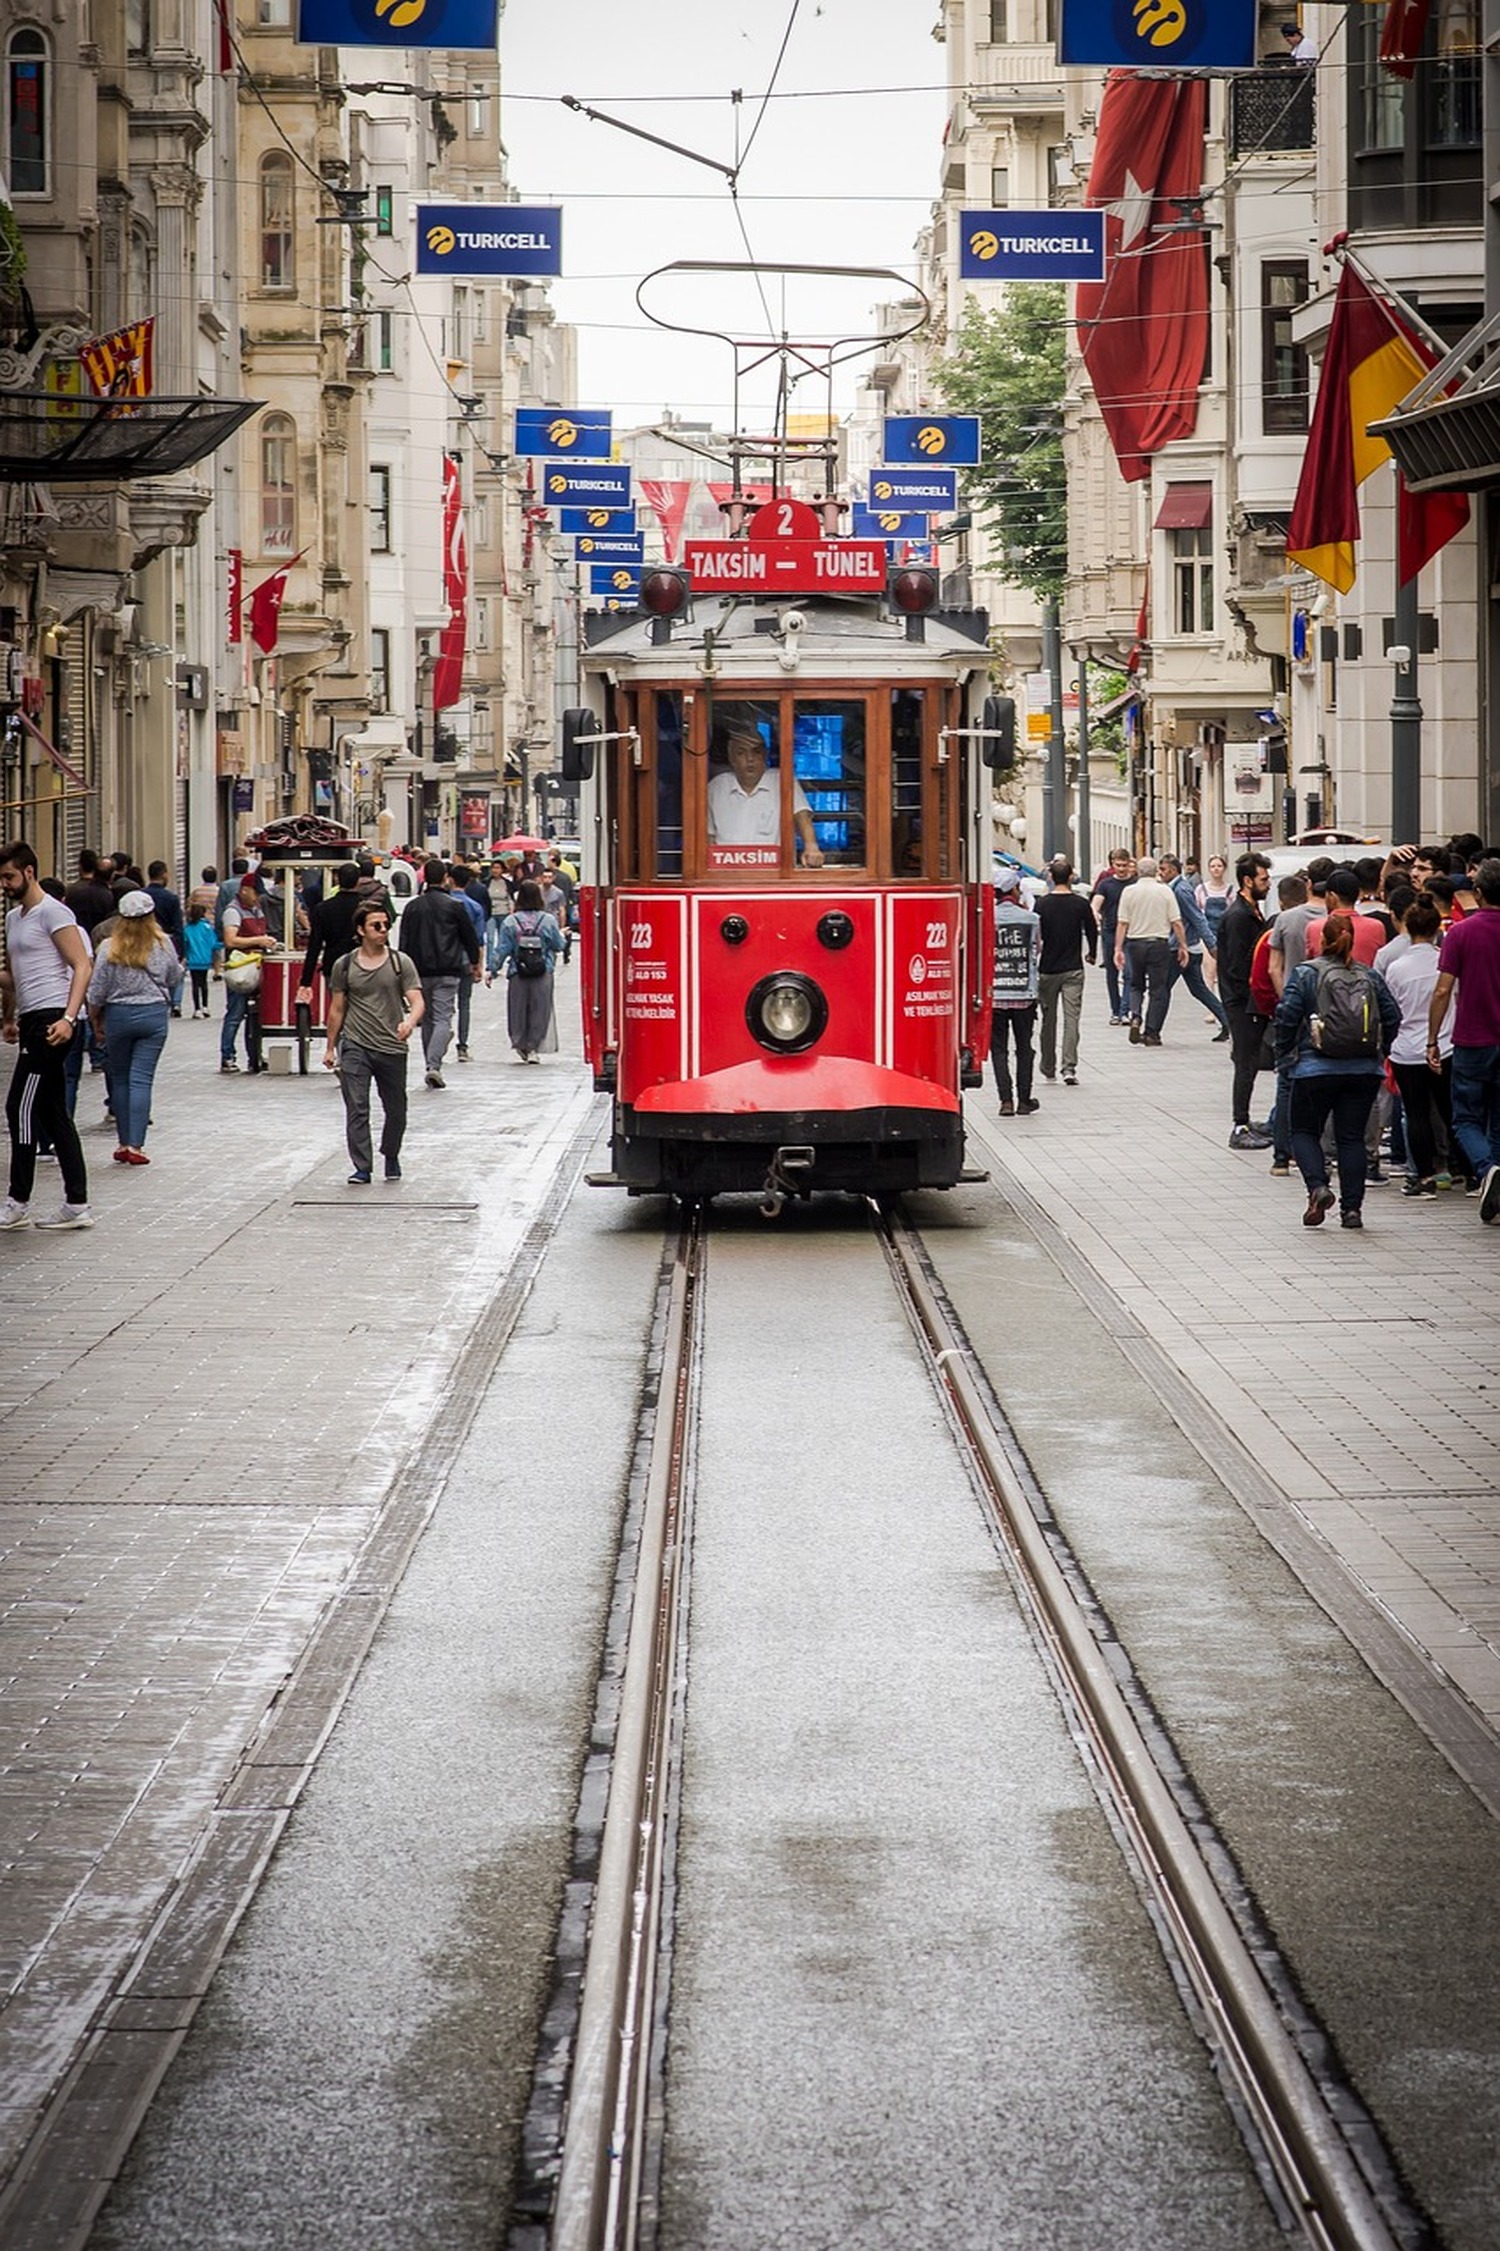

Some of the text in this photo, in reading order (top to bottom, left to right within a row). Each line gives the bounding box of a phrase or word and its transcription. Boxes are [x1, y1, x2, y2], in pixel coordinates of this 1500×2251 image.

[456, 233, 551, 249] TURKCELL
[999, 237, 1094, 253] TURKCELL
[567, 479, 625, 491] TURKCELL
[892, 485, 950, 497] TURKCELL
[777, 504, 793, 536] 2
[595, 542, 641, 552] TURKCELL
[691, 546, 767, 579] TAKSİM
[814, 544, 880, 577] TÜNEL
[712, 849, 777, 864] TAKSİM
[630, 922, 653, 949] 223
[926, 922, 947, 949] 223
[998, 928, 1023, 945] THE
